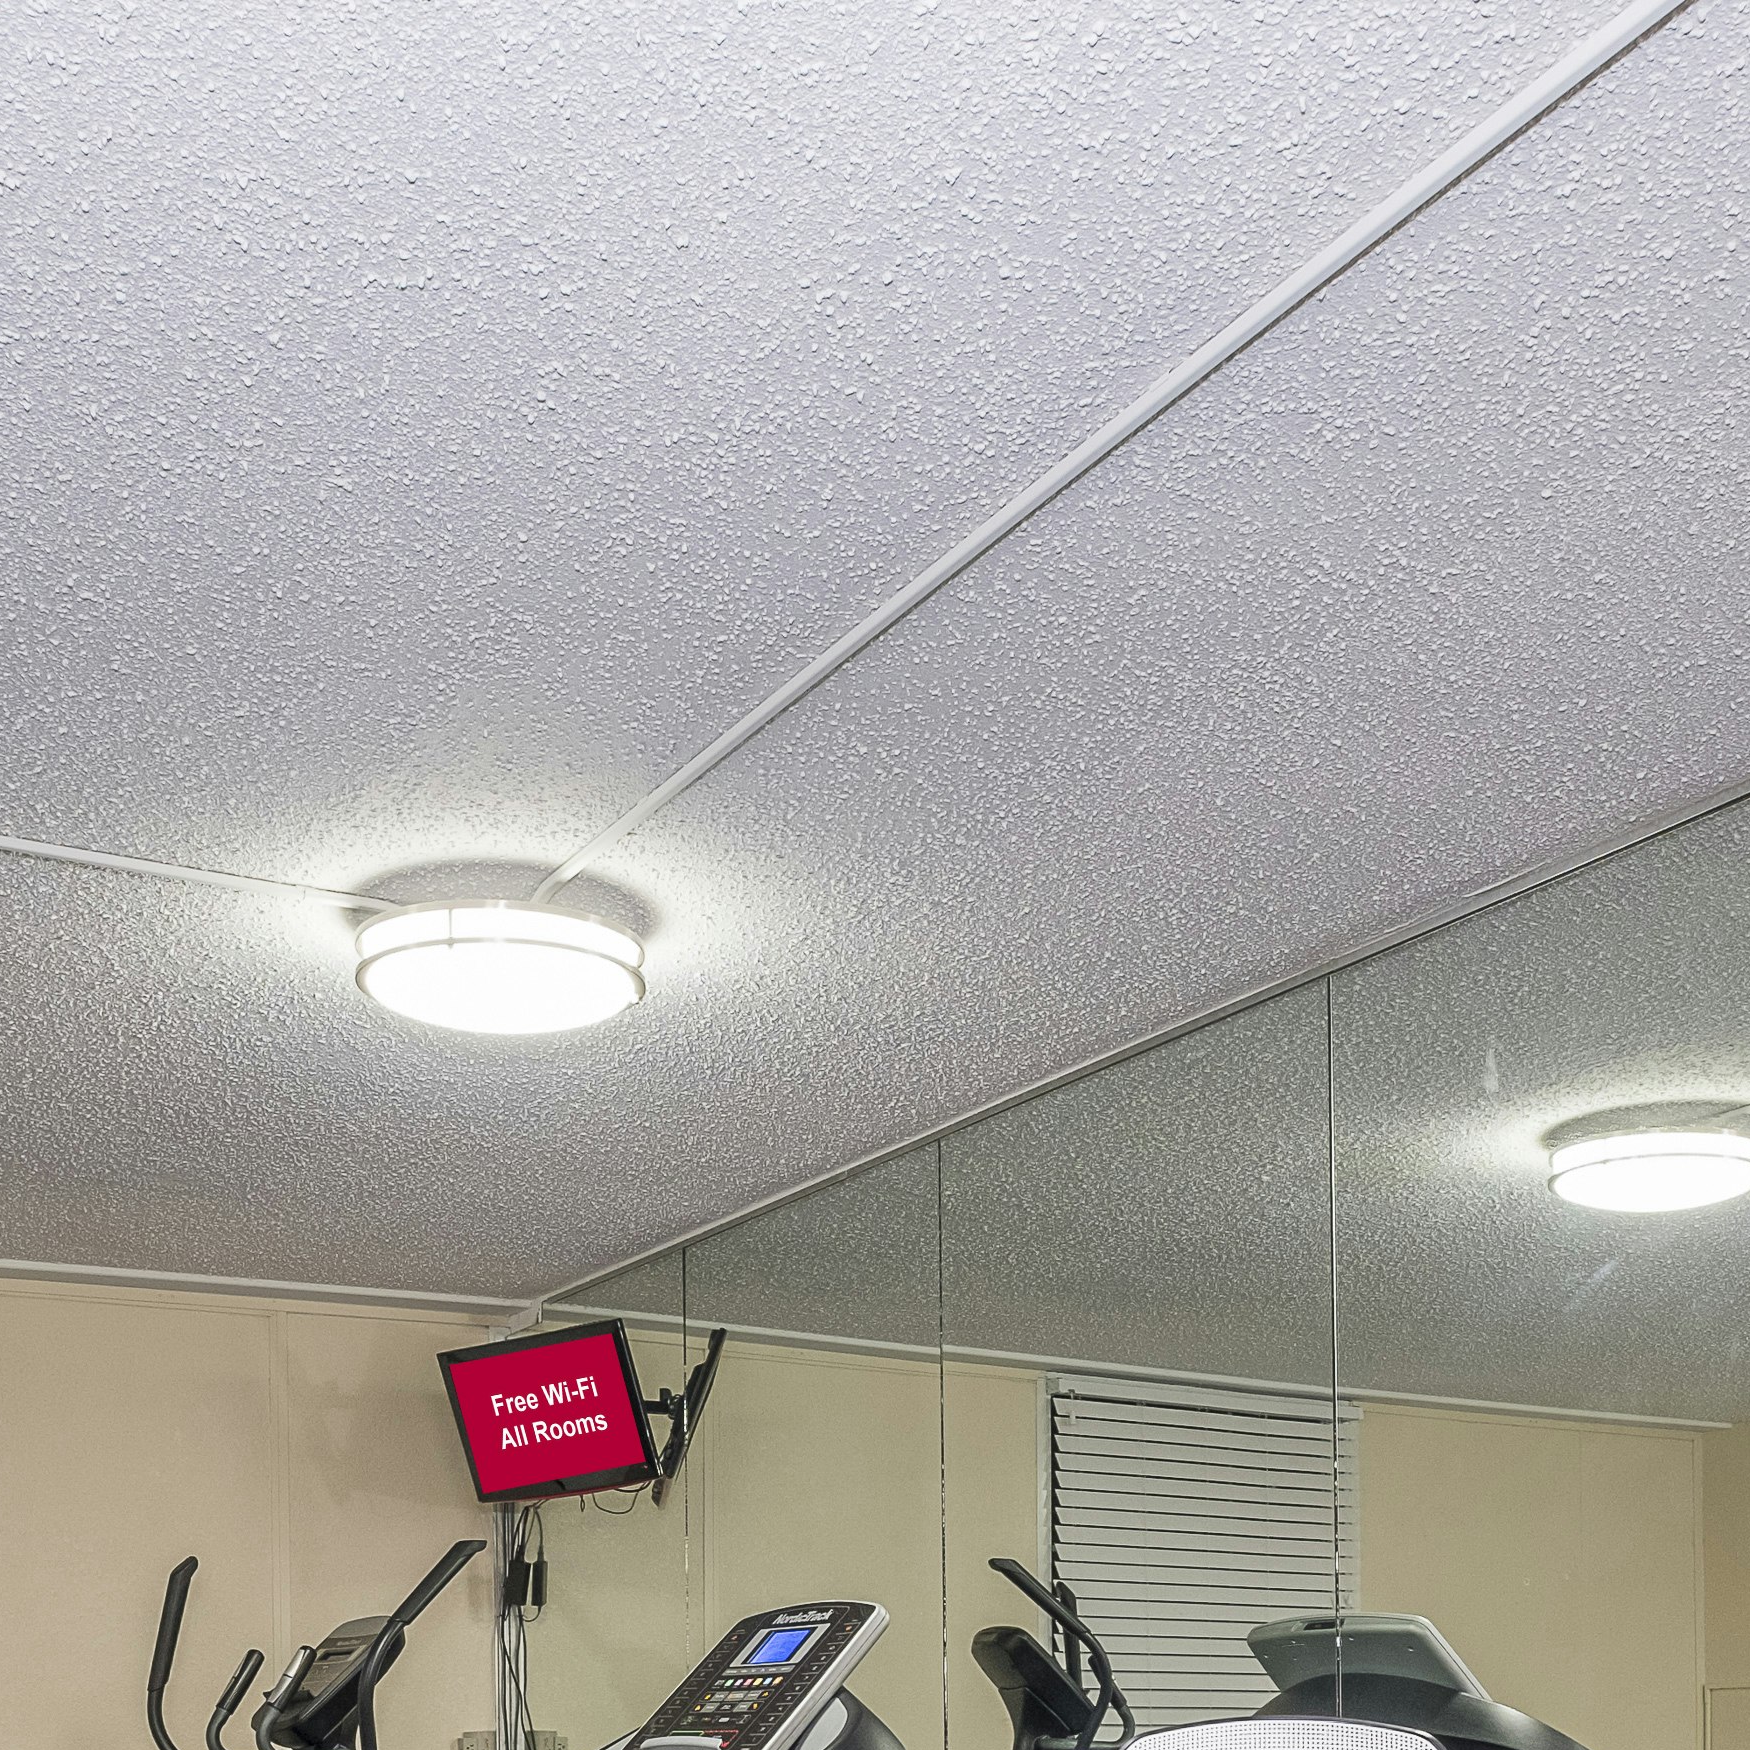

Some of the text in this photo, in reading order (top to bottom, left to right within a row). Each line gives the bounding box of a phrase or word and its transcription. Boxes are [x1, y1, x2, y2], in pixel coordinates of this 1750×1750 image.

[491, 1376, 599, 1417] Free Wi-Fi
[501, 1413, 609, 1450] All Rooms
[772, 1608, 834, 1625] NordicTrack
